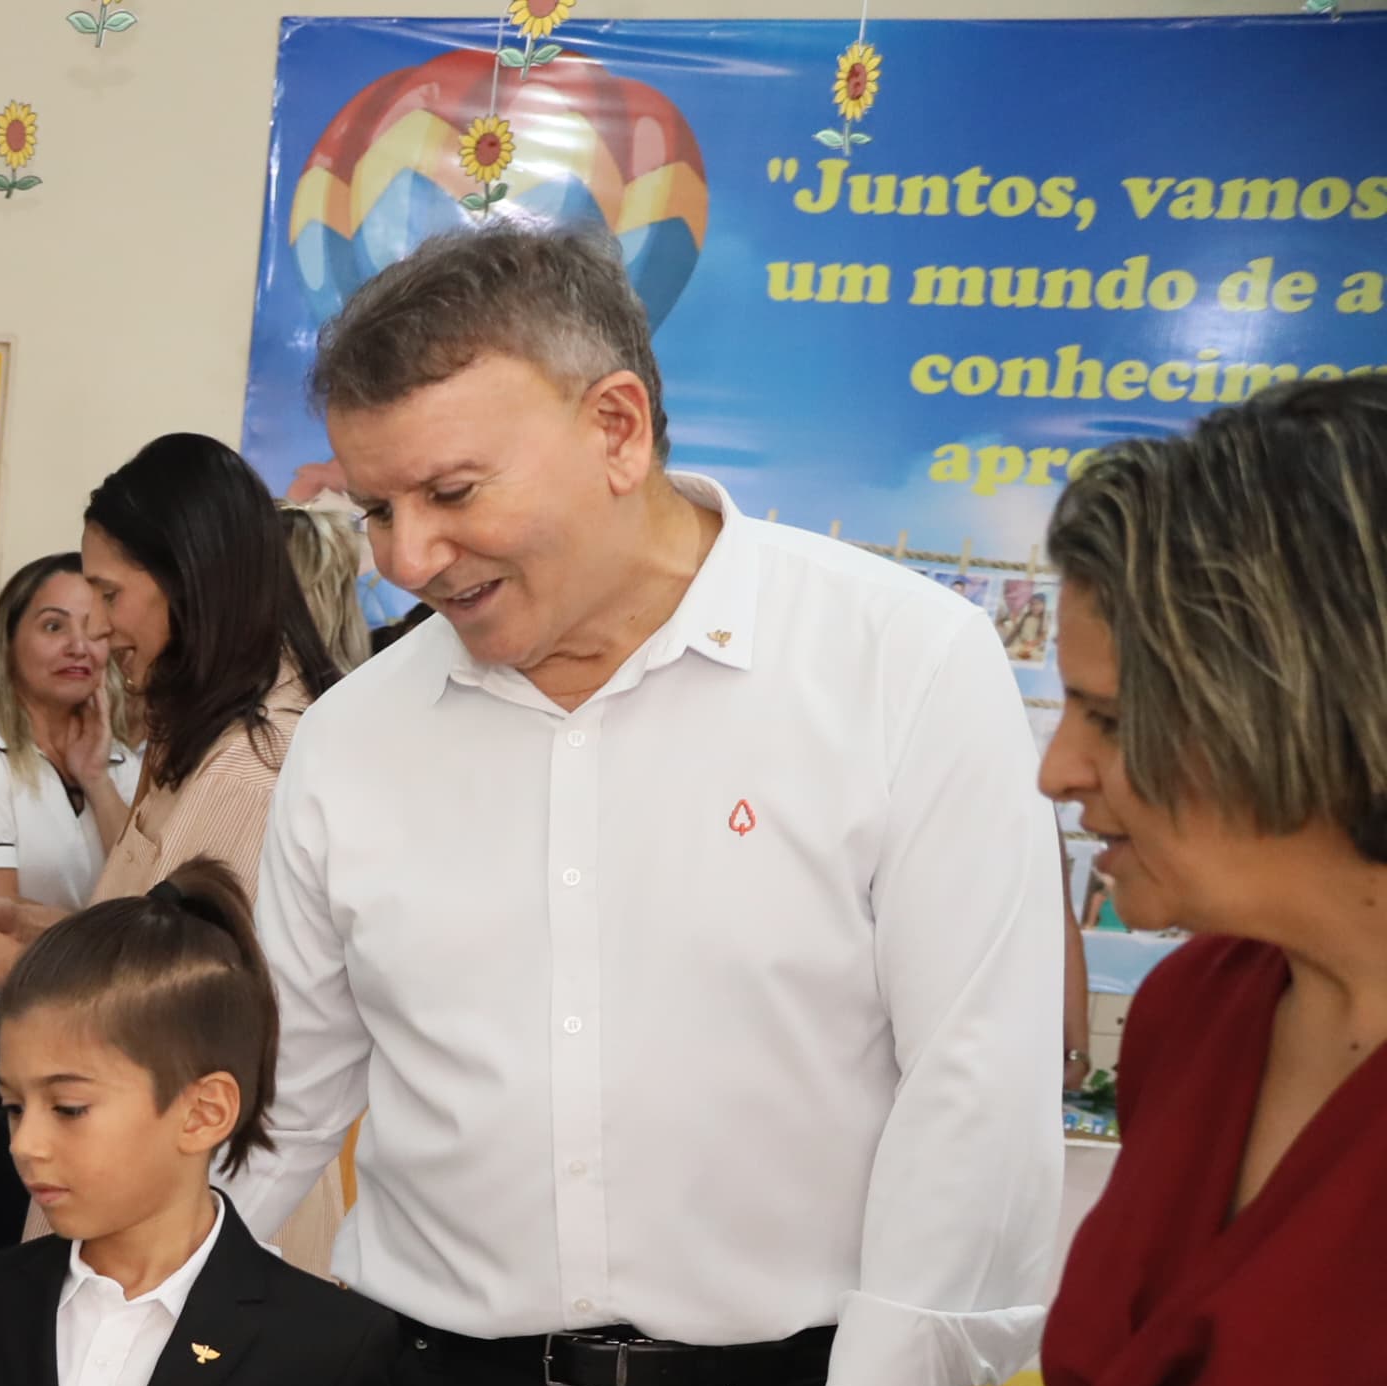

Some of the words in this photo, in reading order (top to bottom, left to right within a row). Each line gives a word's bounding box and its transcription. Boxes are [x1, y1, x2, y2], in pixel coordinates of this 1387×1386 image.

[767, 157, 1096, 232] "Juntos,
[1121, 176, 1387, 221] vamos
[765, 261, 891, 305] um
[908, 255, 1198, 312] mundo
[1217, 256, 1319, 313] de
[910, 344, 1387, 403] conhecim
